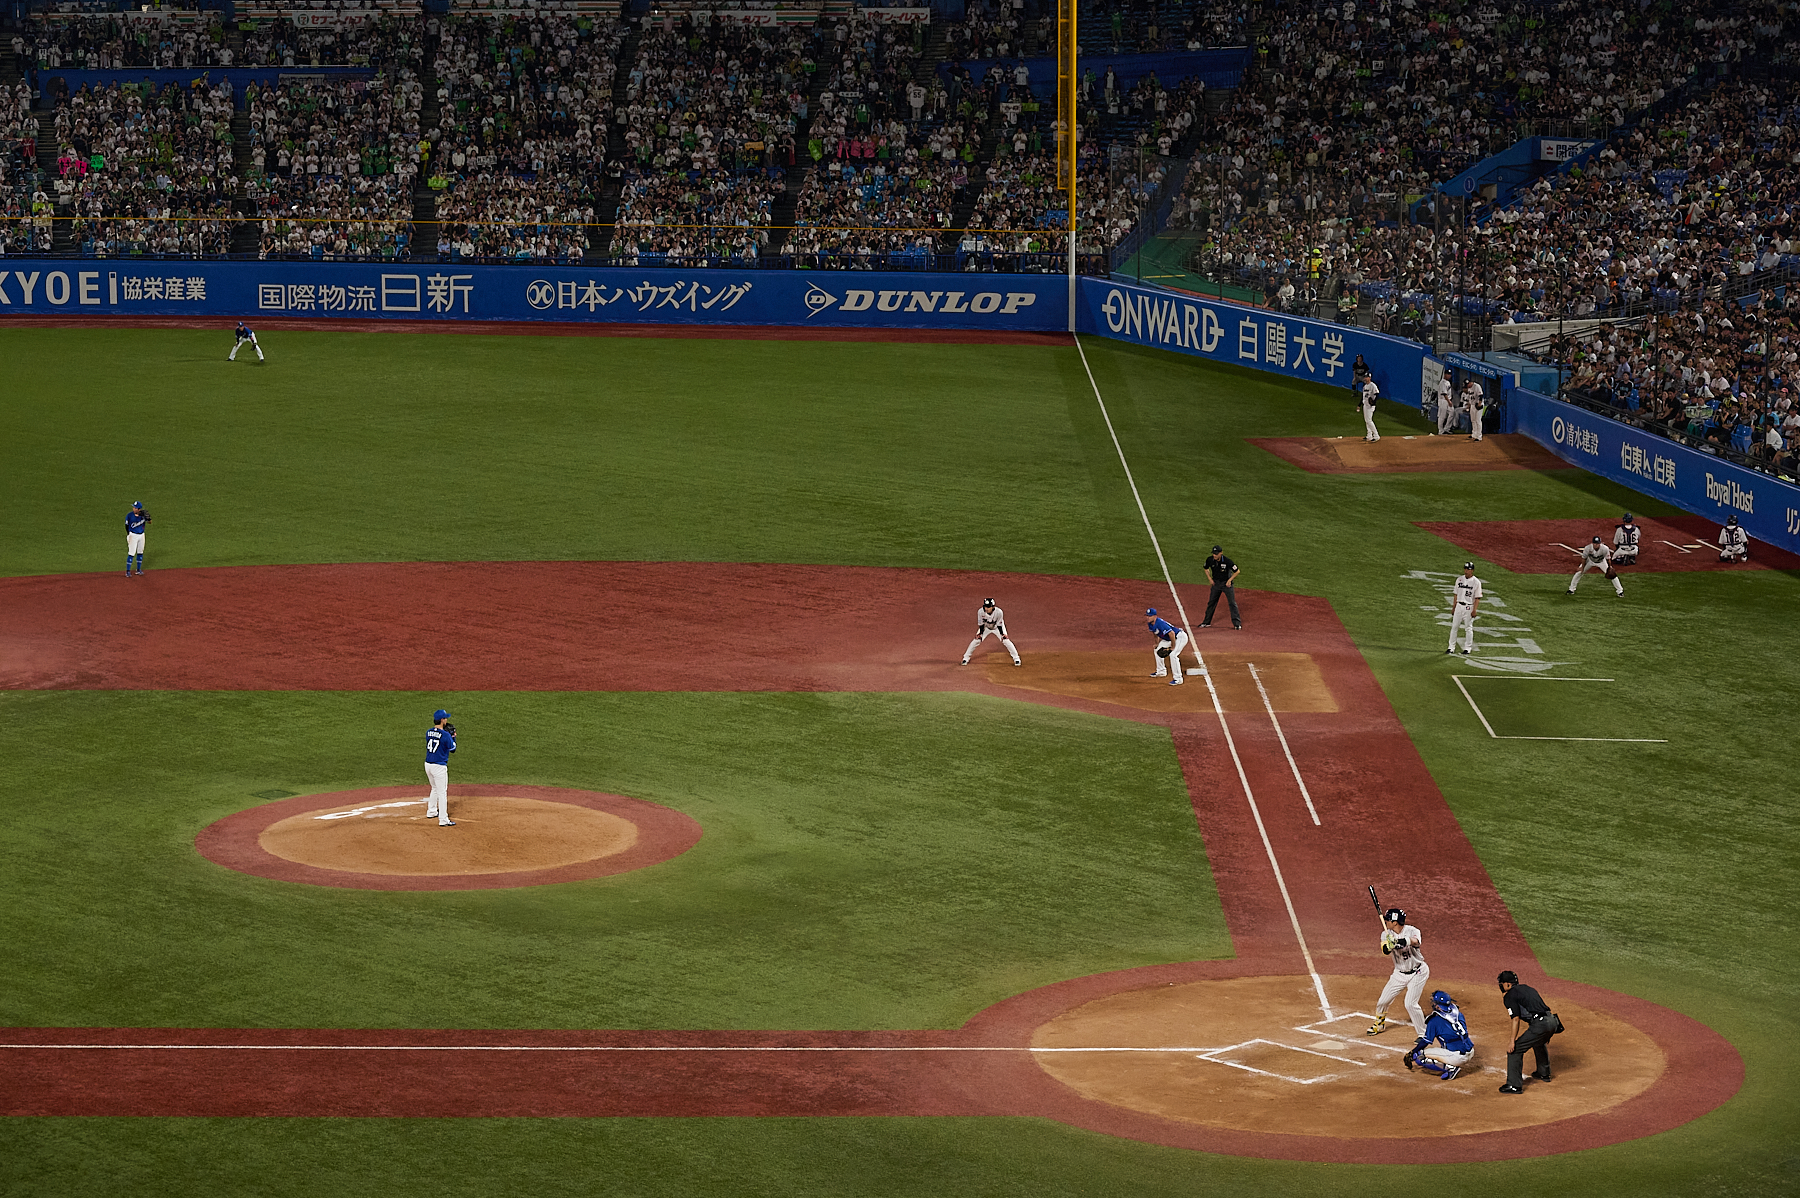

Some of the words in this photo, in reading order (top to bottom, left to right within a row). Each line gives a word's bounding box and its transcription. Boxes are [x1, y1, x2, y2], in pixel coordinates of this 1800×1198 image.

[121, 276, 206, 301] 協栄産業
[557, 279, 753, 312] 日本ハウズイング
[838, 289, 1036, 314] DUNLOP
[1102, 288, 1225, 352] ONWARD
[1566, 421, 1599, 456] 清水建設
[1620, 441, 1643, 476] 伯東
[1653, 453, 1676, 489] 伯東
[1705, 472, 1731, 507] Royal
[1731, 481, 1754, 515] Host
[427, 738, 440, 753] 47
